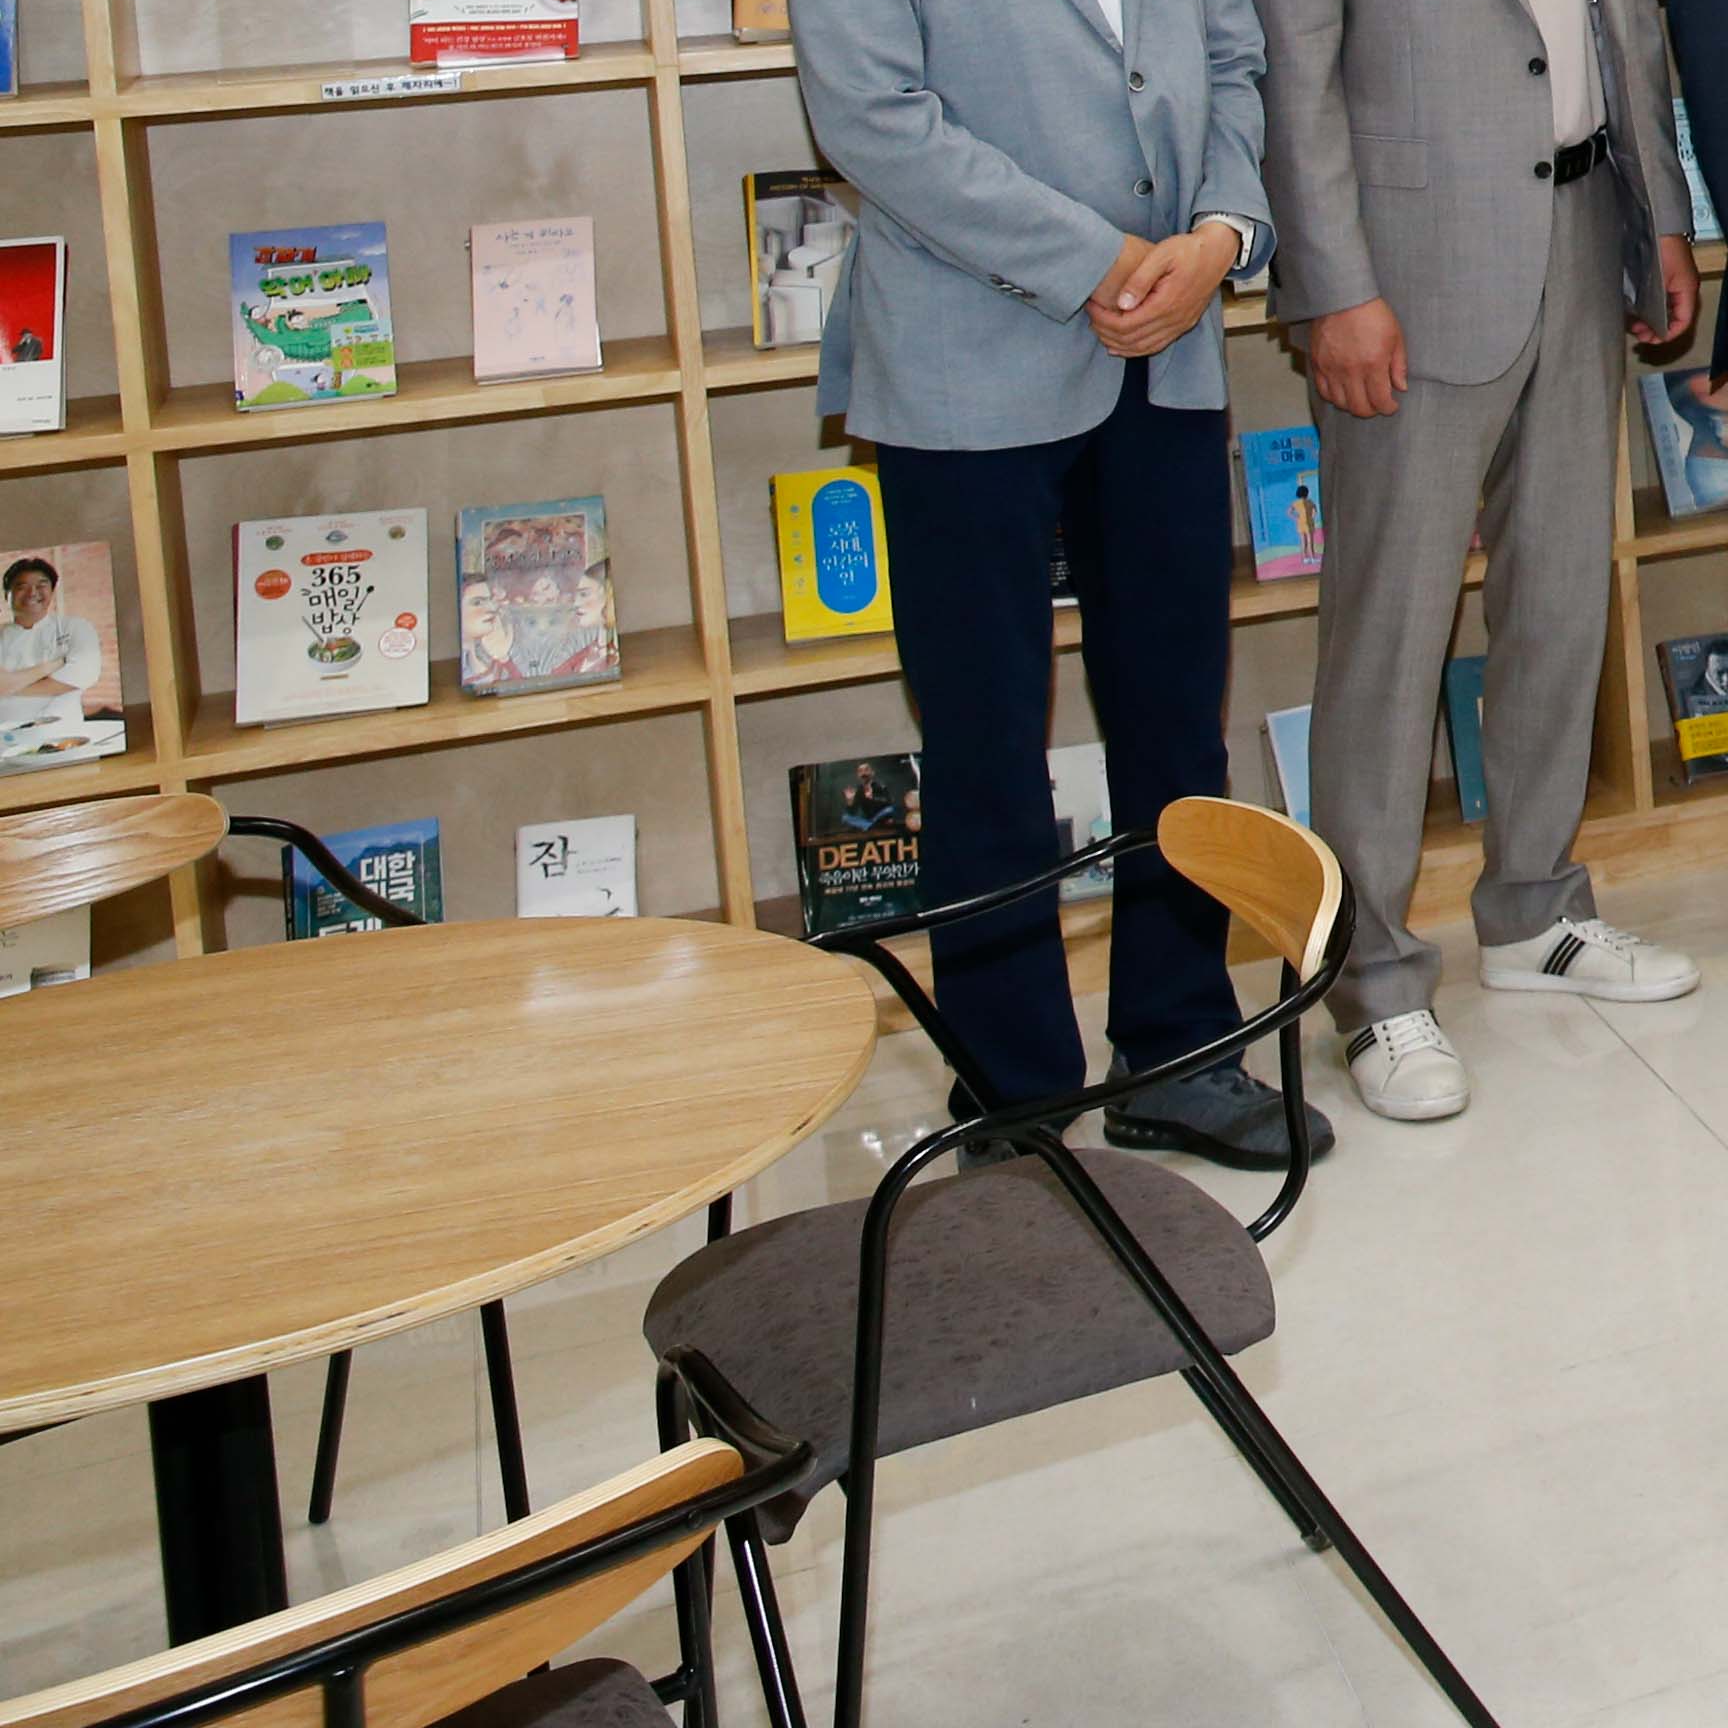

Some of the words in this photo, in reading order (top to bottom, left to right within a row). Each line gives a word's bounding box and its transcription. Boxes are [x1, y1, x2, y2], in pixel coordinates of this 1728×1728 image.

[323, 86, 344, 98] 책을
[259, 276, 314, 300] 악어
[318, 264, 373, 294] 아빠
[827, 520, 860, 538] 로봇
[821, 552, 870, 571] 인간의
[310, 565, 362, 589] 365
[308, 586, 360, 612] 매일
[311, 611, 361, 635] 밥상
[528, 835, 578, 881] 잠
[818, 836, 920, 871] DEATH
[359, 851, 416, 882] 대한
[817, 866, 868, 885] 죽음이란
